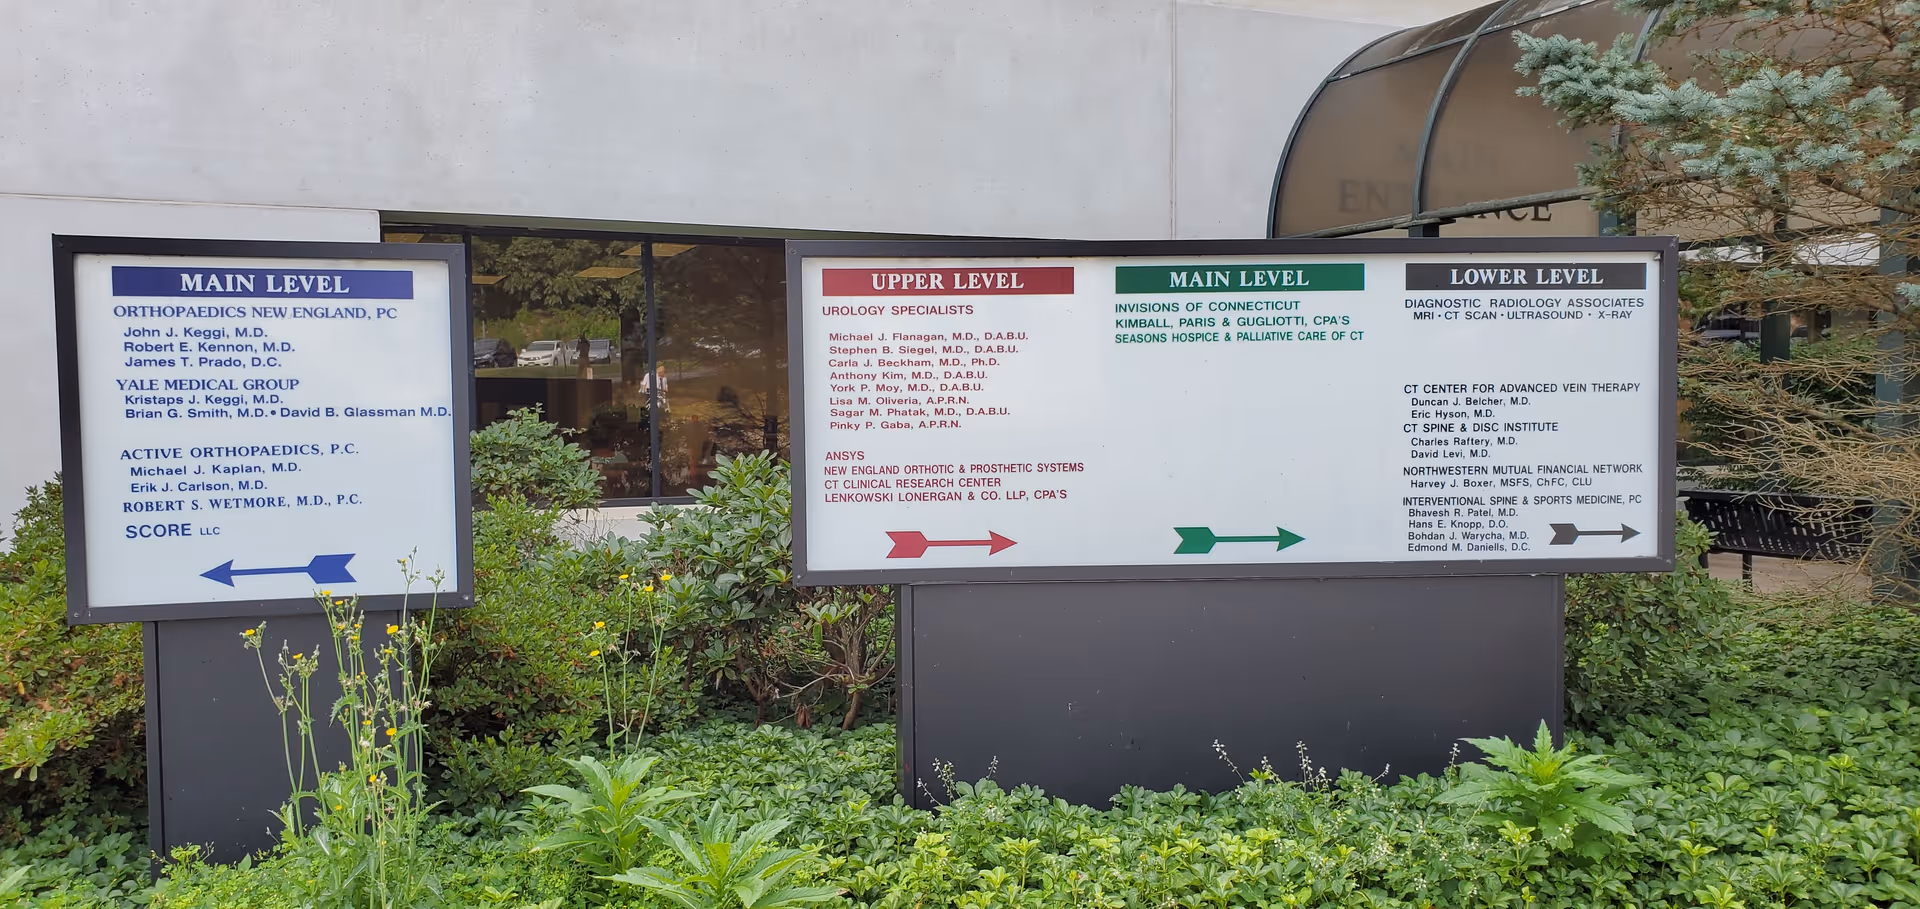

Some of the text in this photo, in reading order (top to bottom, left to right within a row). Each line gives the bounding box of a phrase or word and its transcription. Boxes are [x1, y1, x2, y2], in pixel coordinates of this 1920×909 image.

[871, 272, 1024, 290] UPPER LEVEL
[1169, 270, 1310, 288] MAIN LEVEL
[1450, 268, 1604, 285] LOWER LEVEL
[180, 273, 350, 294] MAIN LEVEL
[1115, 300, 1301, 313] INVISIONS OF CONNECTICUT
[1405, 297, 1644, 309] DIAGNOSTIC RADIOLOGY ASSOCIATES
[113, 305, 397, 320] ORTHOPAEDICS NEW ENGLAND, PC
[822, 304, 974, 316] UROLOGY SPECIALISTS
[1413, 310, 1633, 320] MRI CT SCAN ULTRASOUND X-RAY
[1115, 315, 1350, 330] KIMBALL, PARIS GUGLIOTTI, CPA'S
[123, 327, 268, 340] John Keggi, M.D.
[829, 332, 1029, 343] Michael Flanagan, D.A.B.U.
[1115, 331, 1364, 344] SEASONS HOSPICE PALLIATIVE CARE OF CT
[124, 341, 295, 353] Robert Kennon, M.D.
[829, 345, 1019, 356] Stephen Siegel, D.A.B.U.
[125, 356, 281, 368] James Prado, D.C.
[828, 357, 1000, 368] Carla Beckham, Ph.D.
[830, 371, 988, 381] Anthony Kim, D.A.B.U.
[116, 379, 299, 391] YALE MEDICAL GROUP
[830, 383, 984, 393] York Moy, D.A.B.U.
[1404, 383, 1640, 394] CT CENTER FOR ADVANCED VEIN THERAPY
[125, 394, 283, 407] Kristaps Keggi, M.D.
[829, 396, 969, 406] Lisa Oliveria, A.P.R.N.
[1411, 397, 1506, 406] Duncan Belcher,
[125, 406, 451, 419] Brian Smith, David Glassman M.D.
[830, 407, 1010, 419] Sagar Phatak, D.A.B.U.
[1411, 409, 1470, 420] Eric Hyson,
[830, 420, 962, 431] Pinky Gaba, A.P.R.N.
[1403, 422, 1558, 433] CT SPINE DISC INSTITUTE
[1411, 437, 1493, 447] Charles Raftery,
[120, 443, 359, 460] ACTIVE ORTHOPAEDICS, P.C.
[825, 450, 865, 461] ANSYS
[1411, 449, 1439, 459] David
[130, 462, 301, 477] Michael Kaplan, M.D.
[824, 462, 1084, 476] NEW ENGLAND ORTHOTIC PROSTHETIC SYSTEMS
[1403, 464, 1643, 476] NORTHWESTERN MUTUAL FINANCIAL NETWORK
[131, 480, 267, 493] Erik Carlson, M.D.
[824, 477, 1001, 490] CT CLINICAL RESEARCH CENTER
[1410, 479, 1446, 490] Harvey
[1463, 478, 1496, 488] Boxer,
[1572, 477, 1592, 486] CLU
[825, 489, 1067, 503] LENKOWSKI LONERGAN CO. LLP, CPA'S
[1402, 494, 1642, 506] INTERVENTIONAL SPINE SPORTS MEDICINE, PC
[123, 493, 362, 513] ROBERT WETMORE, P.C.
[1408, 508, 1494, 517] Bhavesh Patel,
[1408, 519, 1433, 529] Hans
[1488, 519, 1508, 529] D.O.
[125, 523, 220, 539] SCORE LLC
[1408, 531, 1505, 542] Bohdan Warycha,
[1408, 543, 1448, 552] Edmond
[1511, 542, 1531, 551] D.C.
